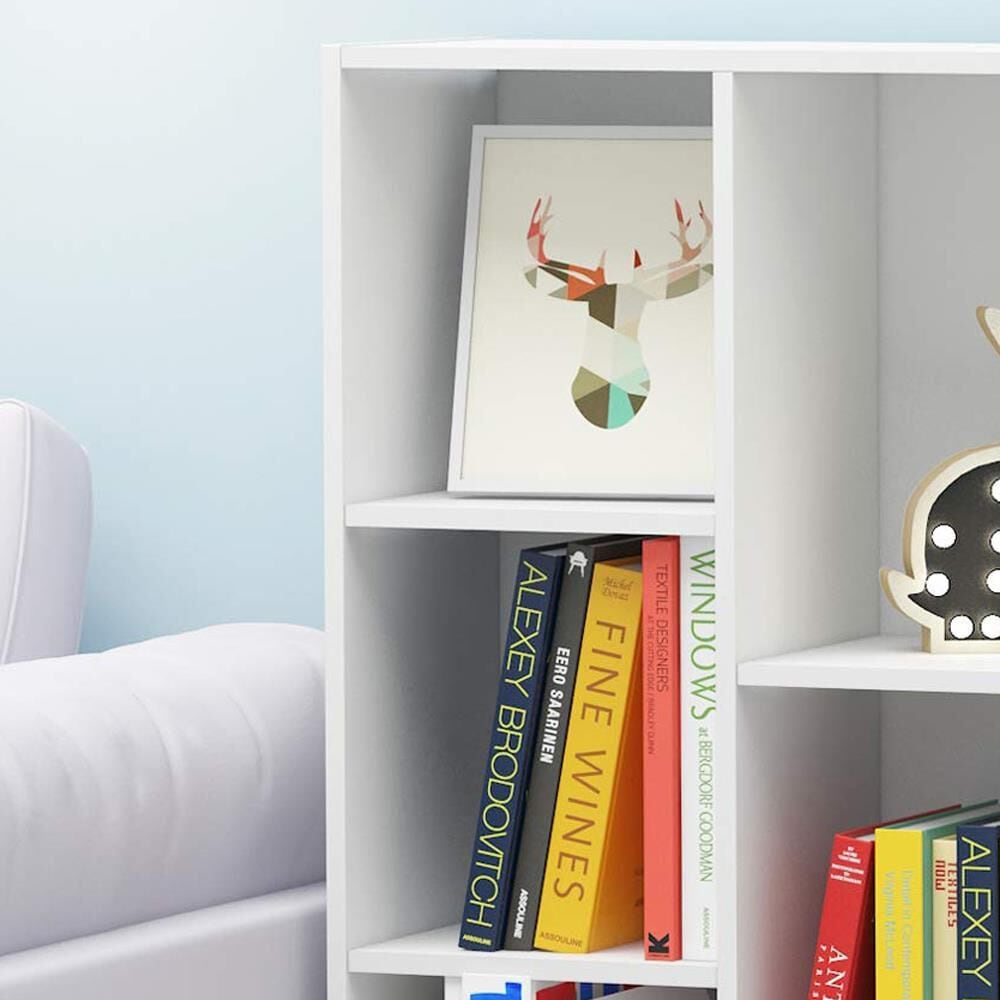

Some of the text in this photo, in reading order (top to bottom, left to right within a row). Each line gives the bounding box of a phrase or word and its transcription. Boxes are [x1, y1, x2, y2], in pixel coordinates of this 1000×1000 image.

[655, 564, 669, 692] TEXTILE DESIGNERS
[466, 560, 549, 929] ALEXEY BRODOVITCH
[540, 647, 571, 764] EERO SAARINEN
[553, 620, 626, 902] FINE WINES
[690, 549, 715, 882] WINDOWS at BERGDORF GOODMAN
[463, 933, 492, 946] ASSOULINE
[513, 889, 529, 940] ASSOULINE
[538, 931, 583, 948] ASSOULINE
[648, 932, 670, 954] K
[961, 834, 992, 987] ALEXEY
[813, 944, 827, 998] PARIS
